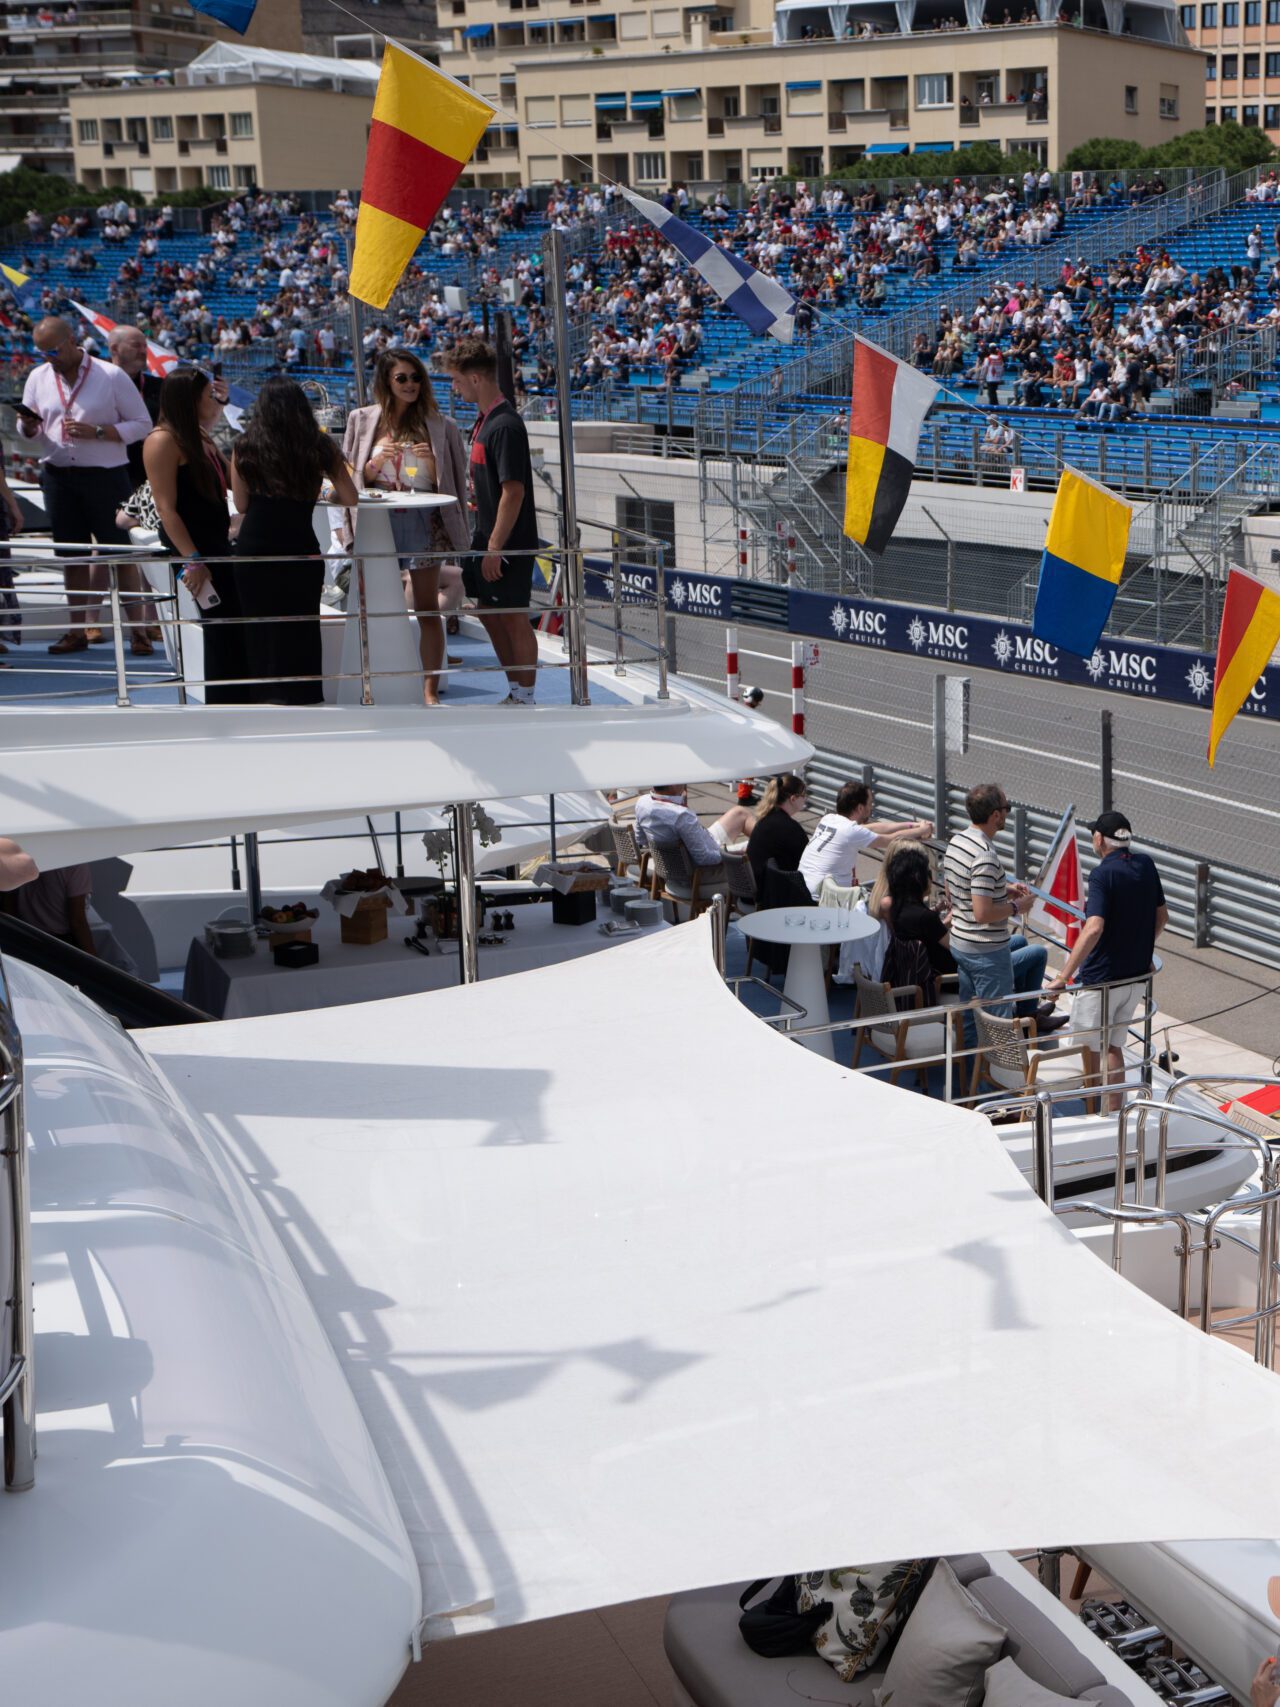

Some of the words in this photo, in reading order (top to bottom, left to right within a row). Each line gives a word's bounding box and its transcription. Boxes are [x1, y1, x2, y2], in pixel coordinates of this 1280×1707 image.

[620, 572, 652, 594] MSC
[688, 582, 722, 606] MSC
[688, 605, 722, 616] CRUISES
[850, 608, 887, 634] MSC
[850, 632, 887, 646] CRUISES
[928, 622, 968, 649] MSC
[928, 647, 968, 660] CRUISES
[1015, 636, 1058, 665] MSC
[1014, 662, 1059, 677] CRUISES
[1109, 650, 1157, 680] MSC
[1108, 678, 1157, 693] CRUISES
